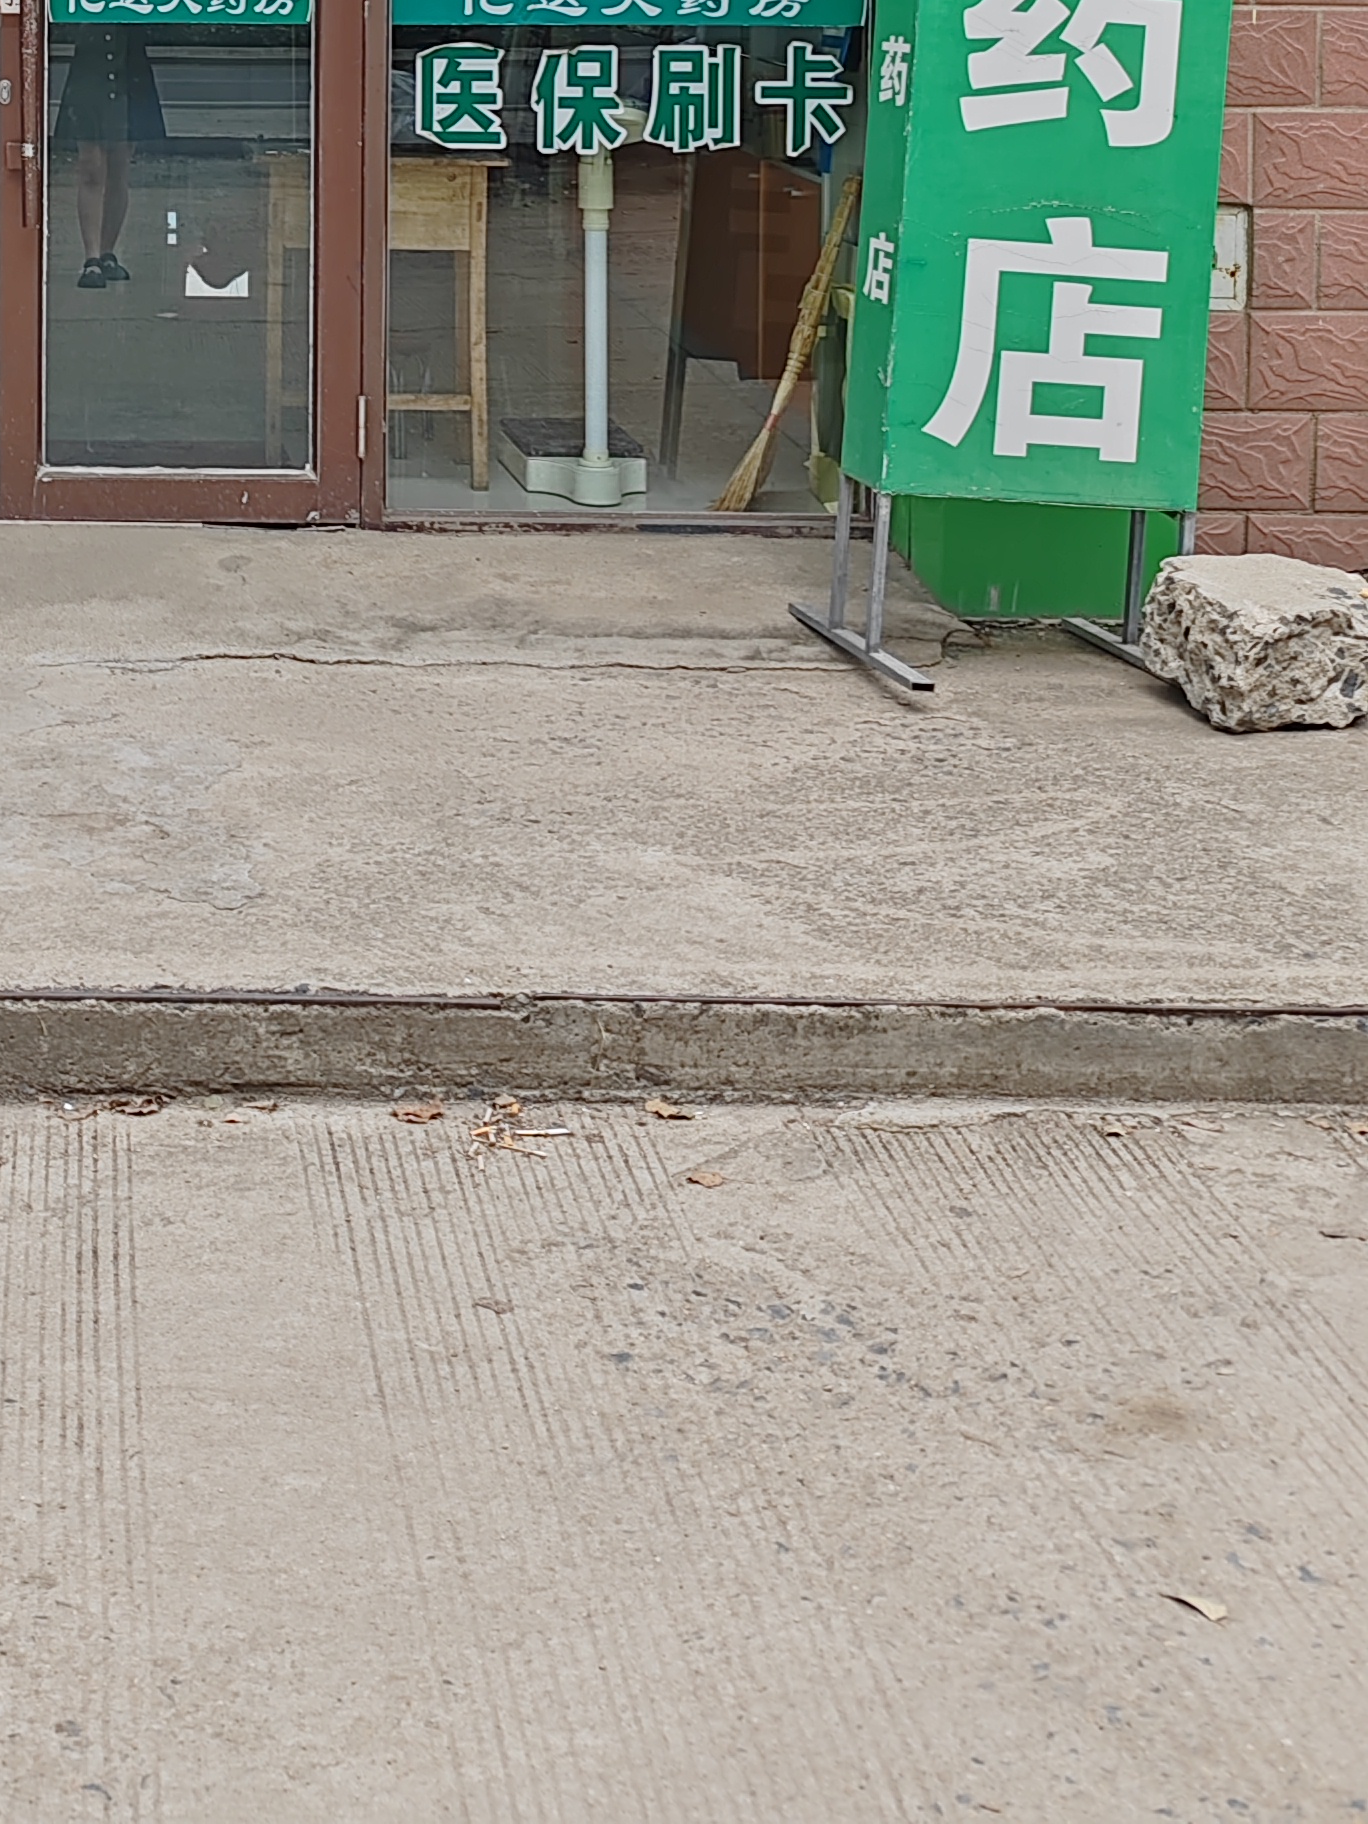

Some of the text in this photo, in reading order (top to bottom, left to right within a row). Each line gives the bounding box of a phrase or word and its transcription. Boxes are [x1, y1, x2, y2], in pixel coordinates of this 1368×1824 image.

[415, 41, 853, 157] 医保刷卡
[862, 35, 911, 306] 药店
